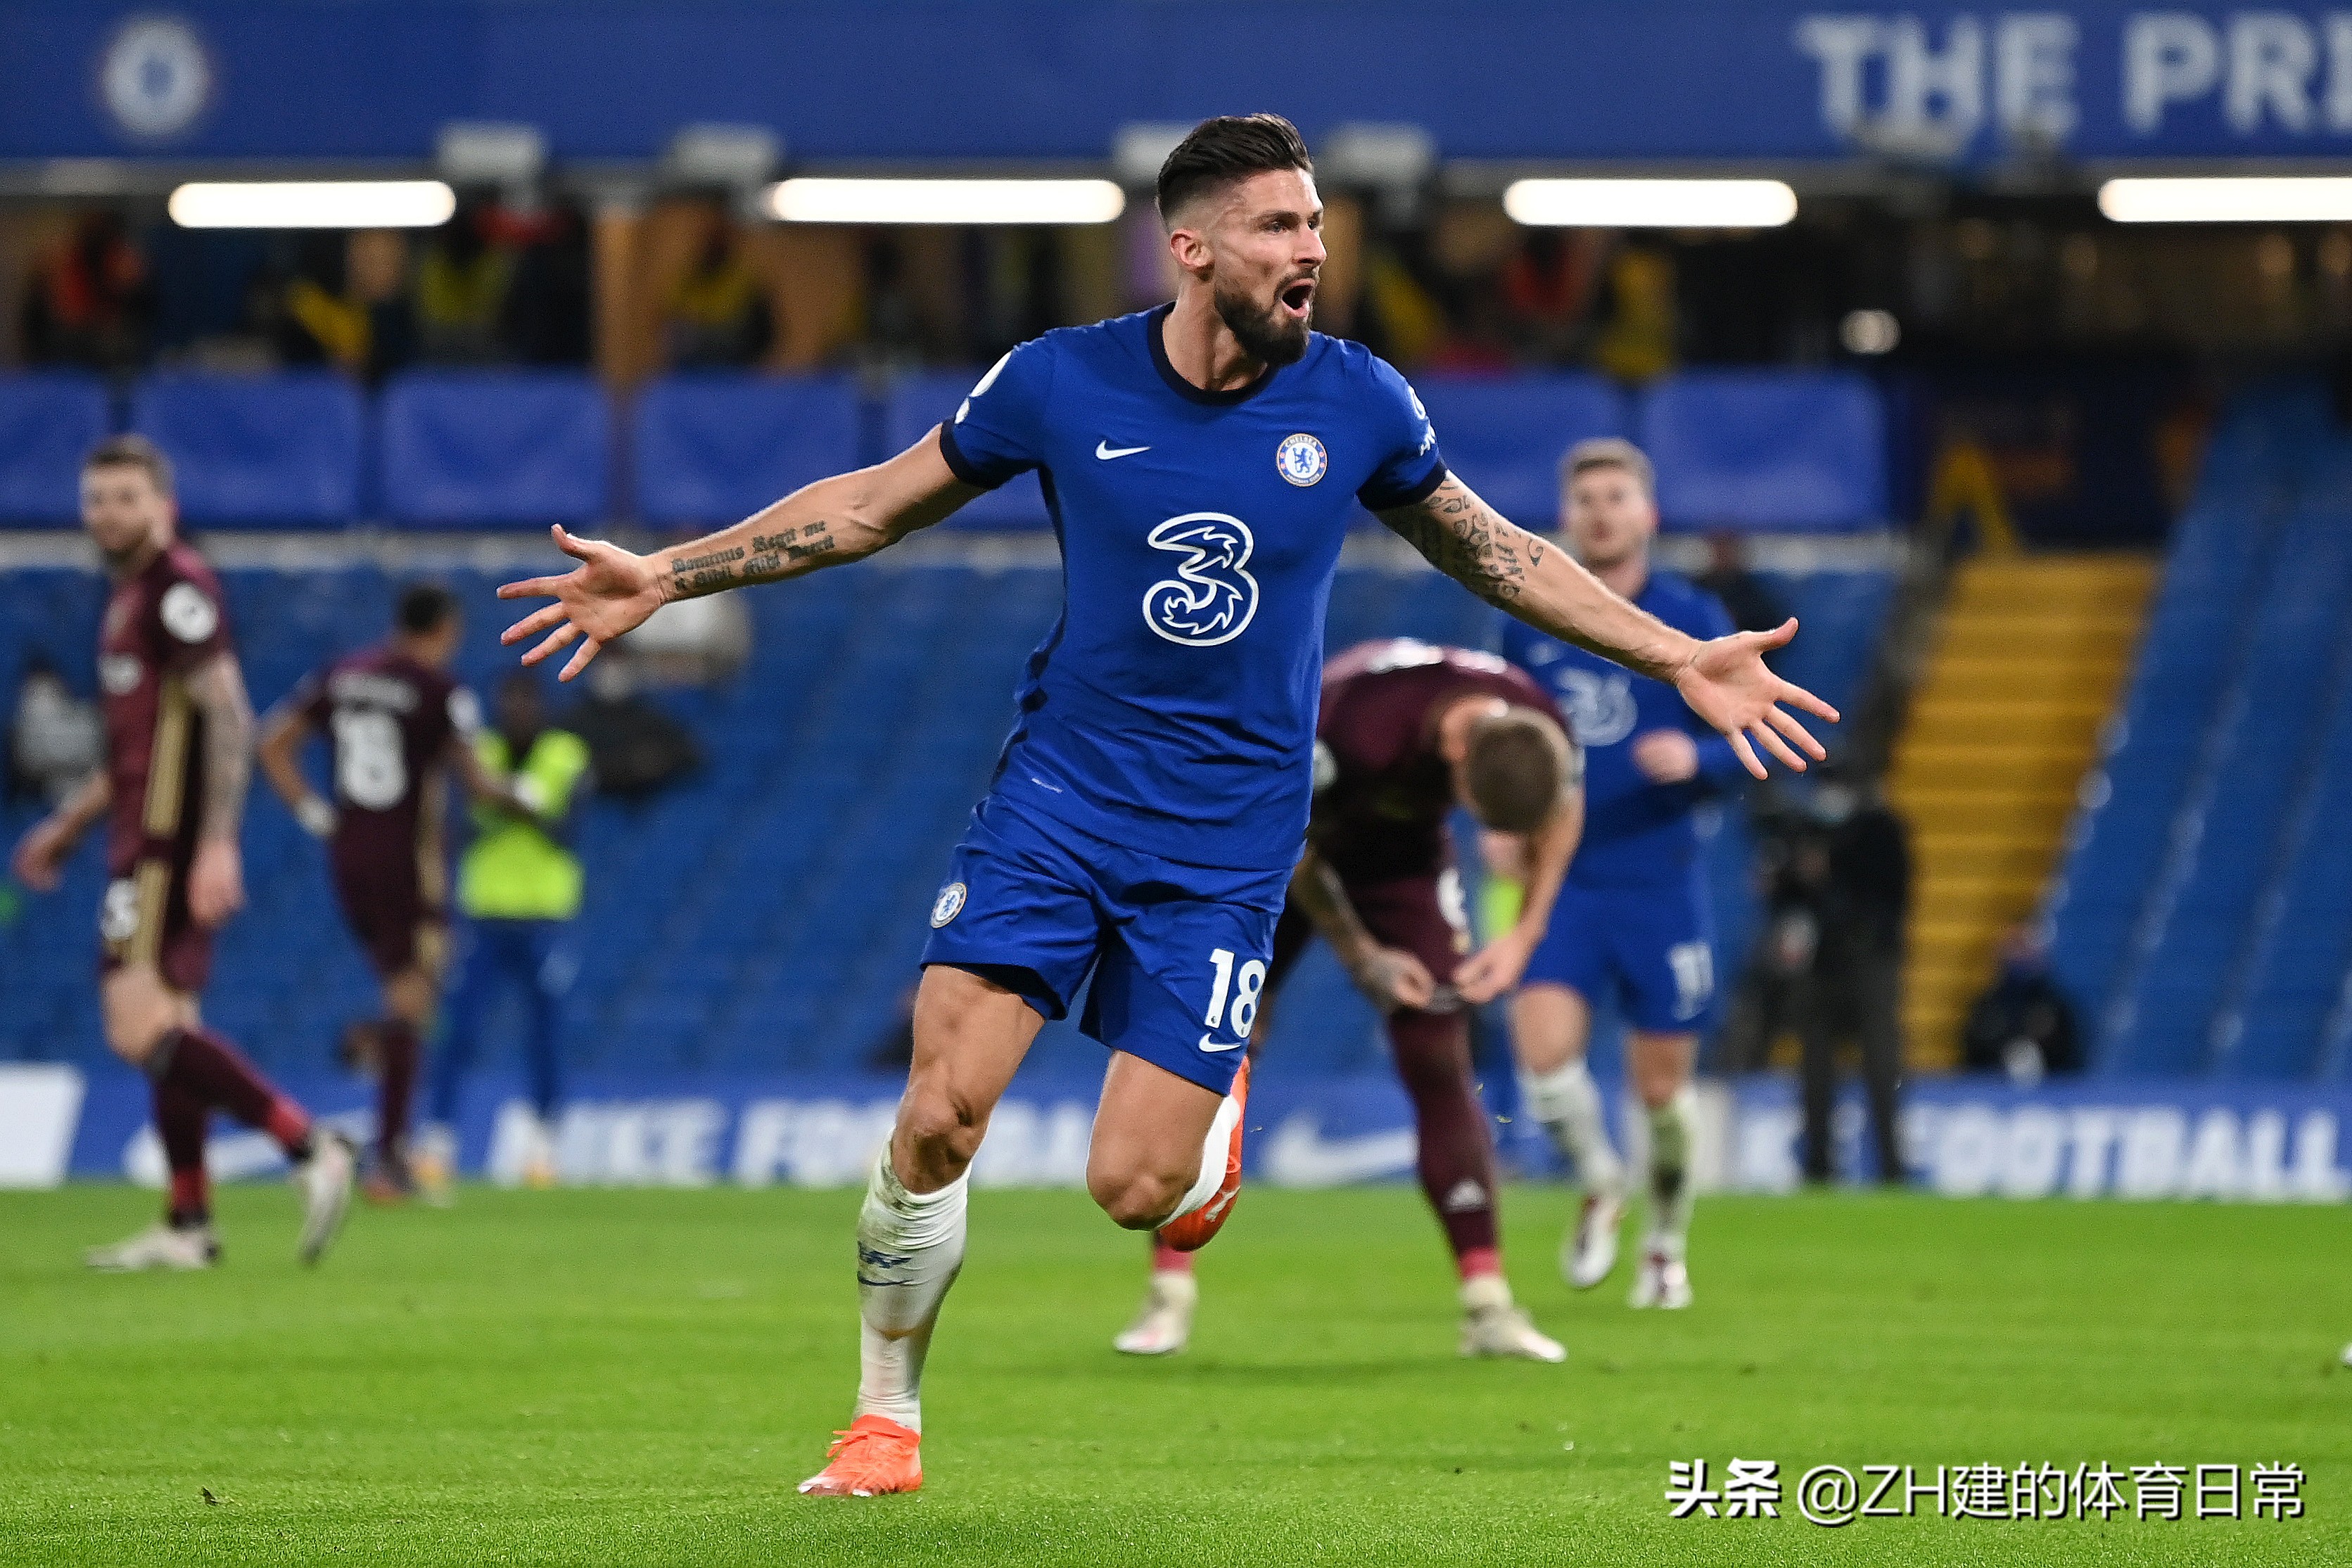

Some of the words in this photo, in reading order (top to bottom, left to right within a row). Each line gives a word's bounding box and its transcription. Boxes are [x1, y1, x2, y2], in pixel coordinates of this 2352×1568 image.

[1798, 14, 2080, 139] THE
[1142, 512, 1259, 646] 3
[1204, 948, 1266, 1039] 18
